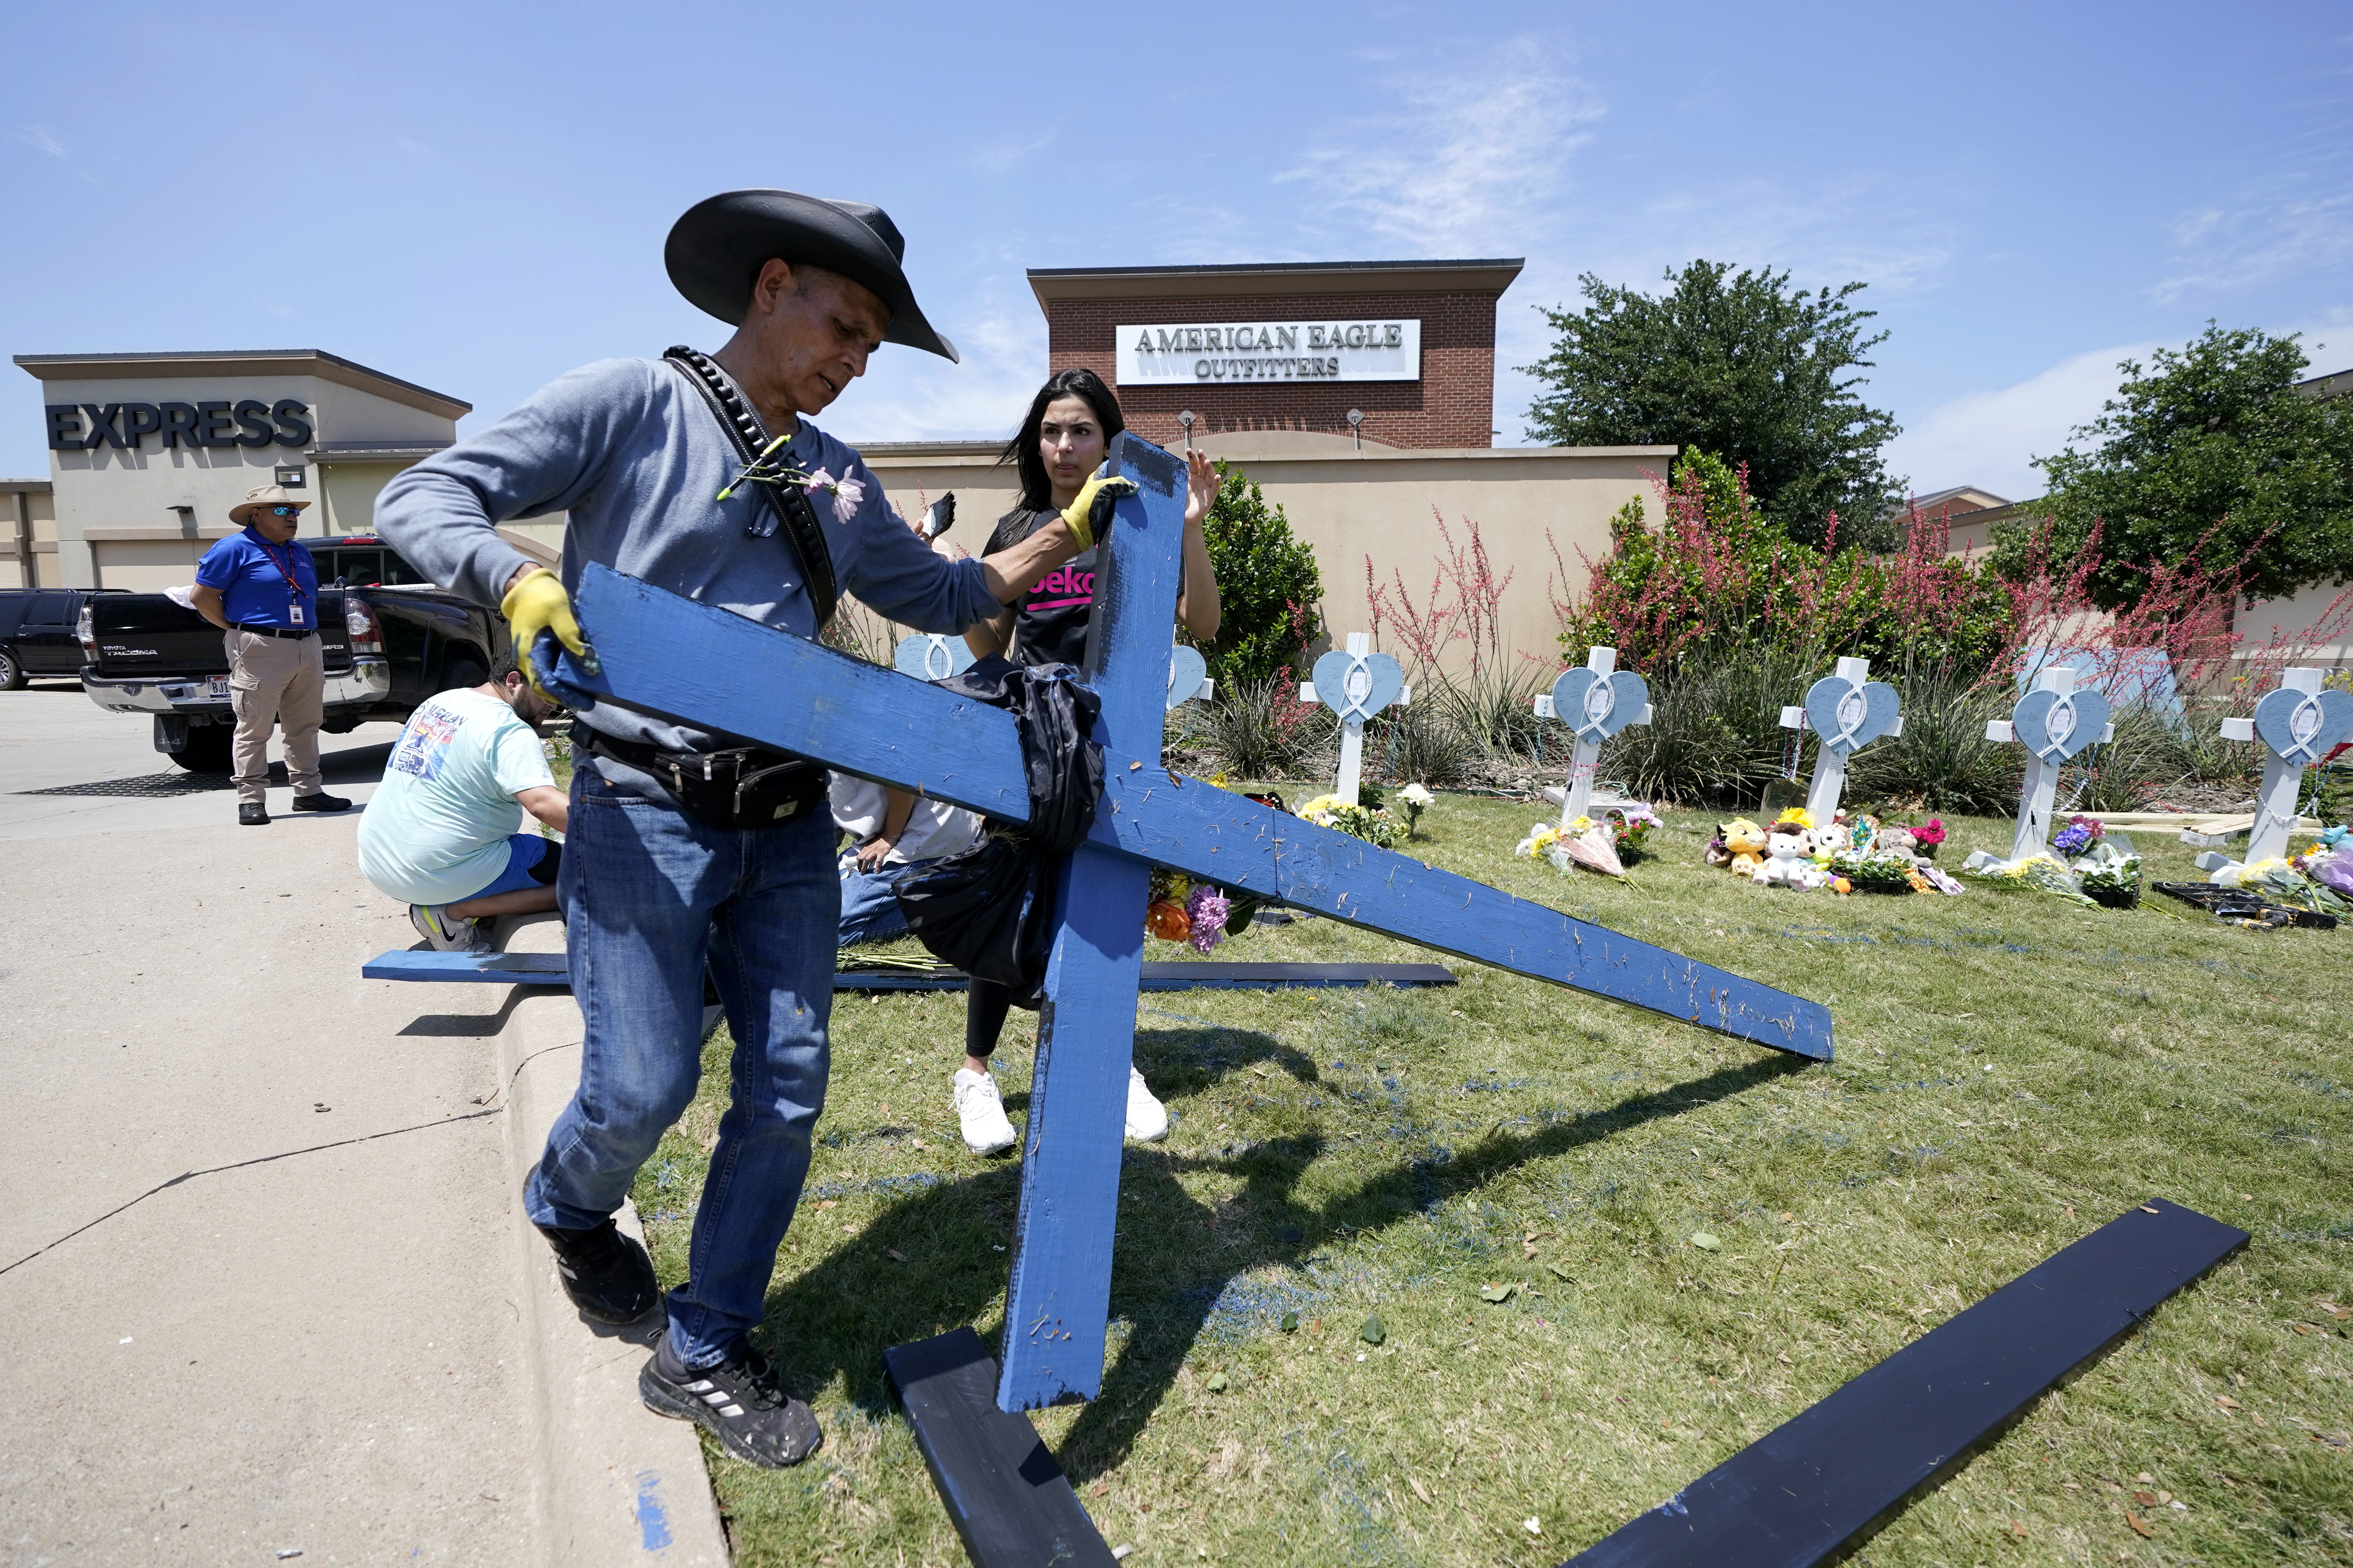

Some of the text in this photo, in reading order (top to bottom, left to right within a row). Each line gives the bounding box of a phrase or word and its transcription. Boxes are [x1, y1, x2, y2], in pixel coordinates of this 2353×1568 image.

[1134, 324, 1402, 351] AMERICAN EAGLE
[1195, 356, 1340, 377] OUTFITTERS
[44, 399, 311, 450] EXPRESS
